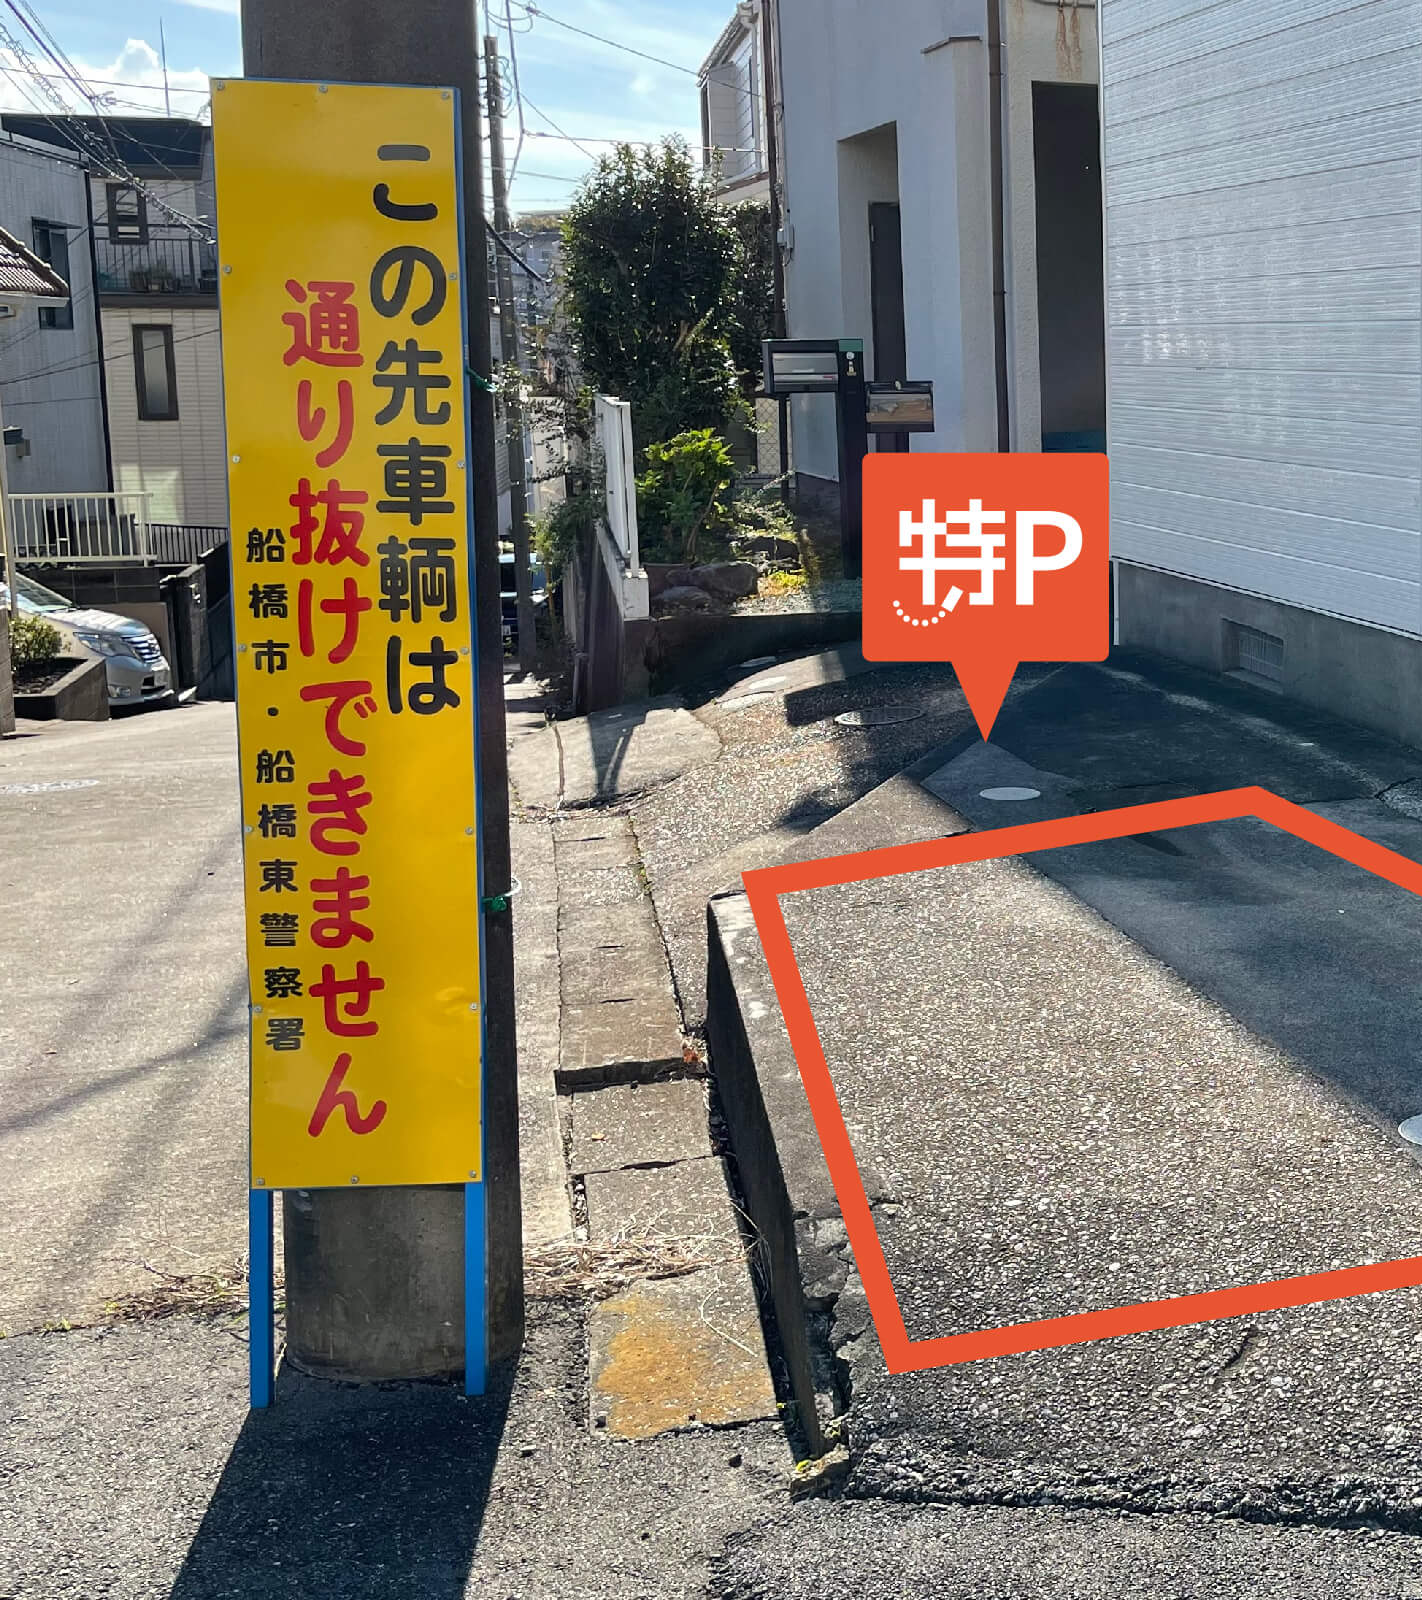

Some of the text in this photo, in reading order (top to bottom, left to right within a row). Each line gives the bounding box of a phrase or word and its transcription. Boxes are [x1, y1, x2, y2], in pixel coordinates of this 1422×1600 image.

[280, 279, 387, 1138] 通り抜けできません
[369, 144, 461, 716] この先車輌は
[245, 527, 305, 1052] 船橋市・船橋東警察署
